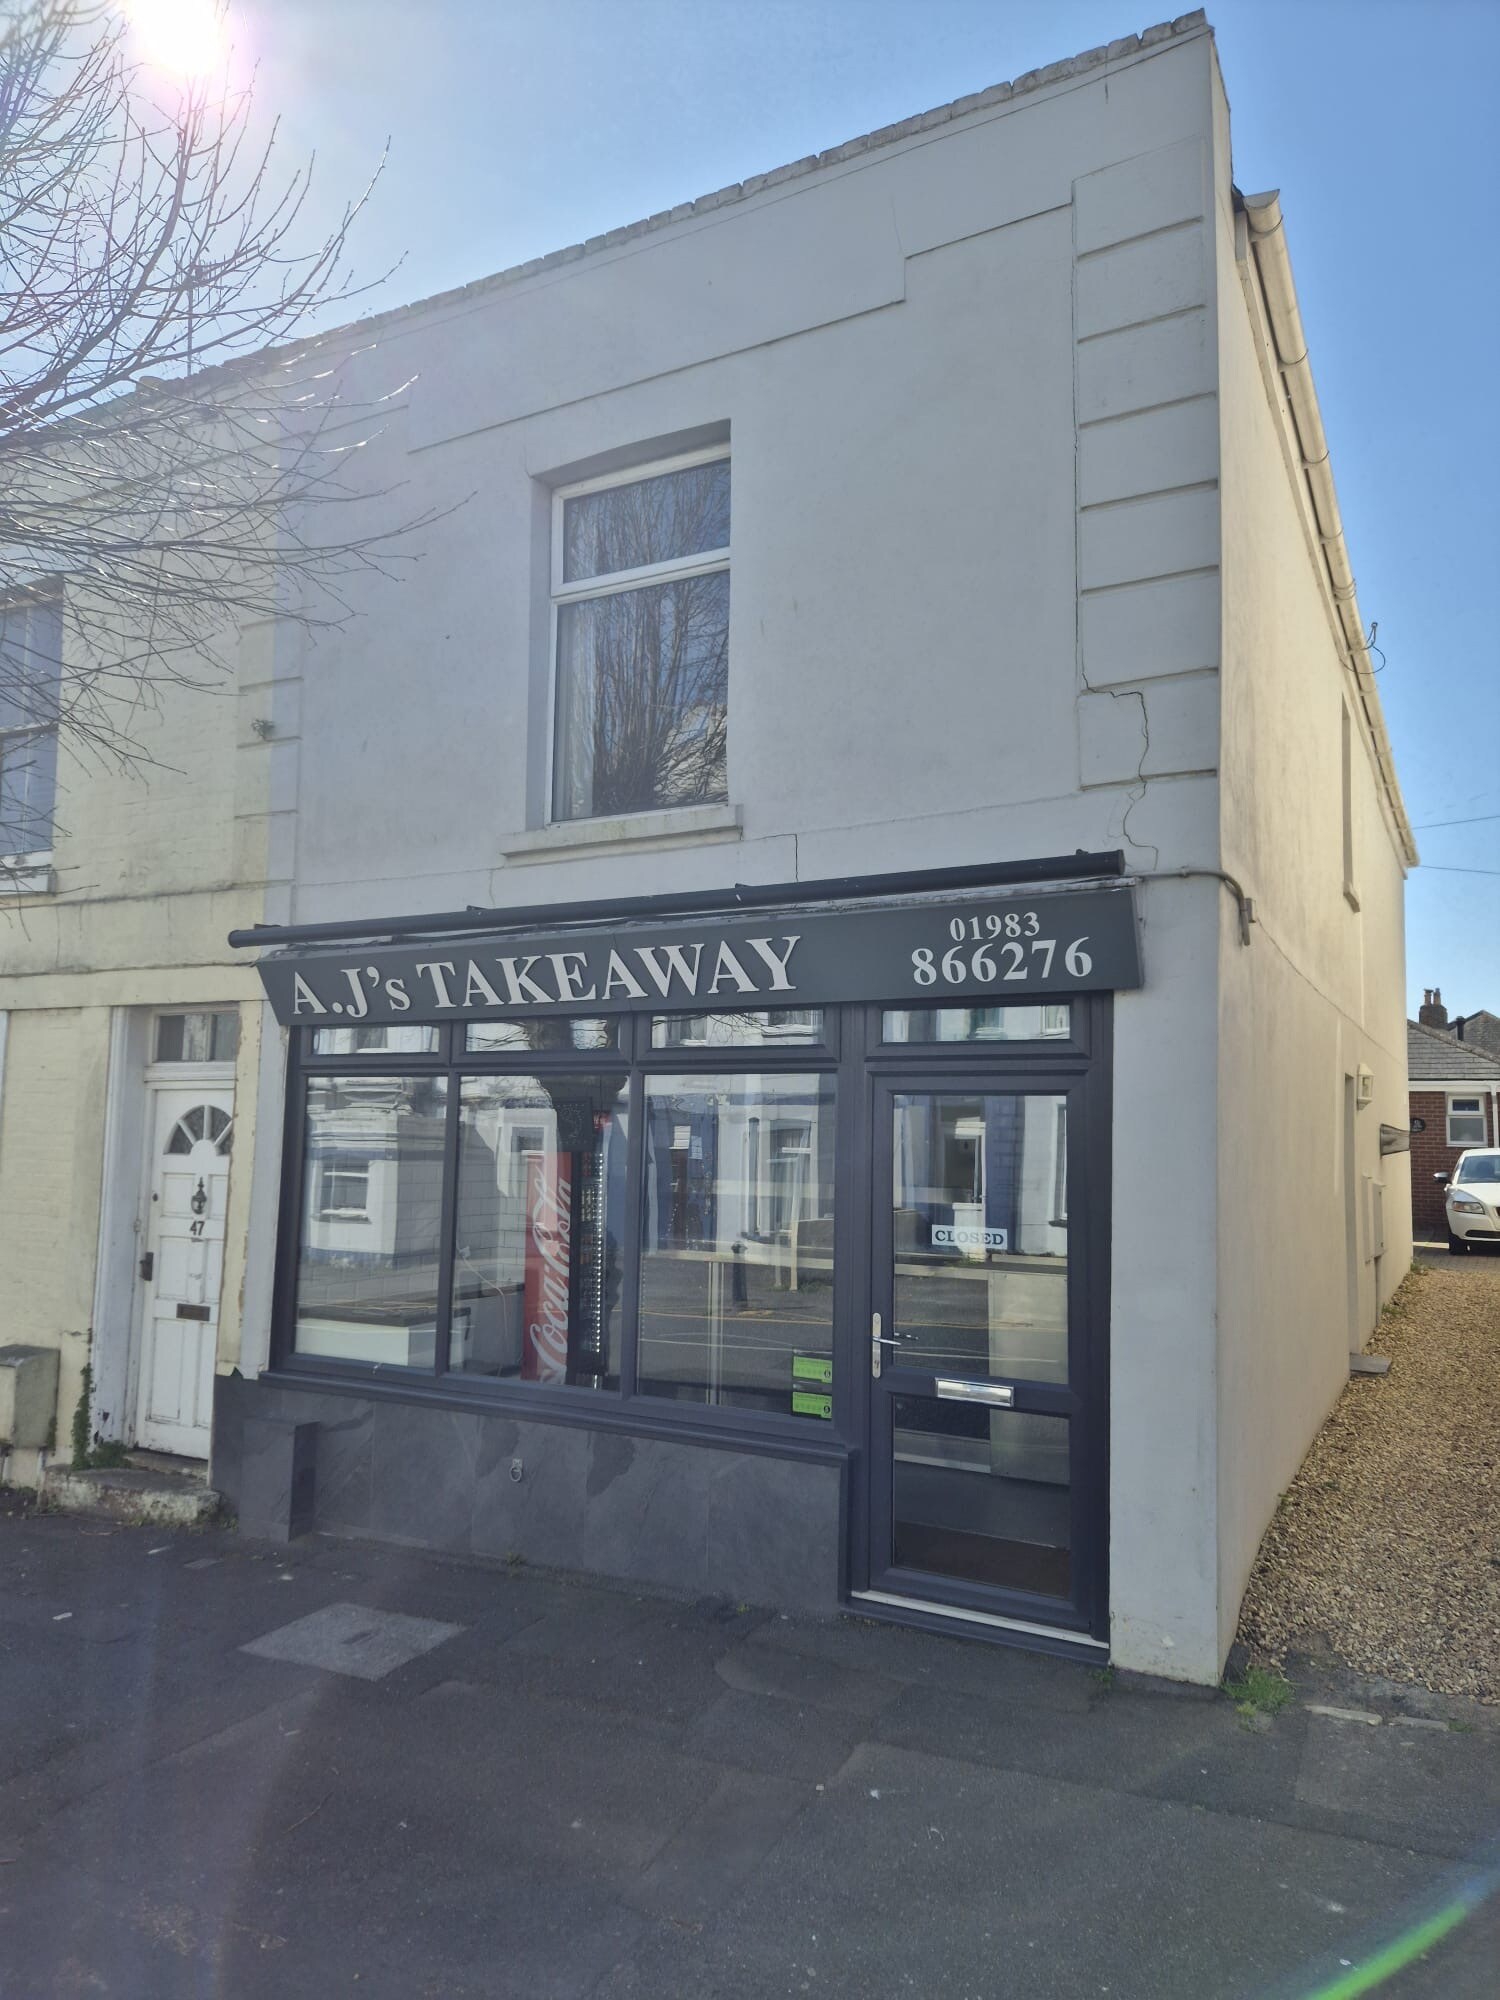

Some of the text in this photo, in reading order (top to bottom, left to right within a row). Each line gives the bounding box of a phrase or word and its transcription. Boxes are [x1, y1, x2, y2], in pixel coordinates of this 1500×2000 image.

[949, 911, 1040, 942] 01983
[415, 935, 801, 1009] TAKEAWAY
[911, 936, 1093, 985] 866276
[190, 1220, 205, 1236] 47
[934, 1230, 1005, 1246] CLOSED
